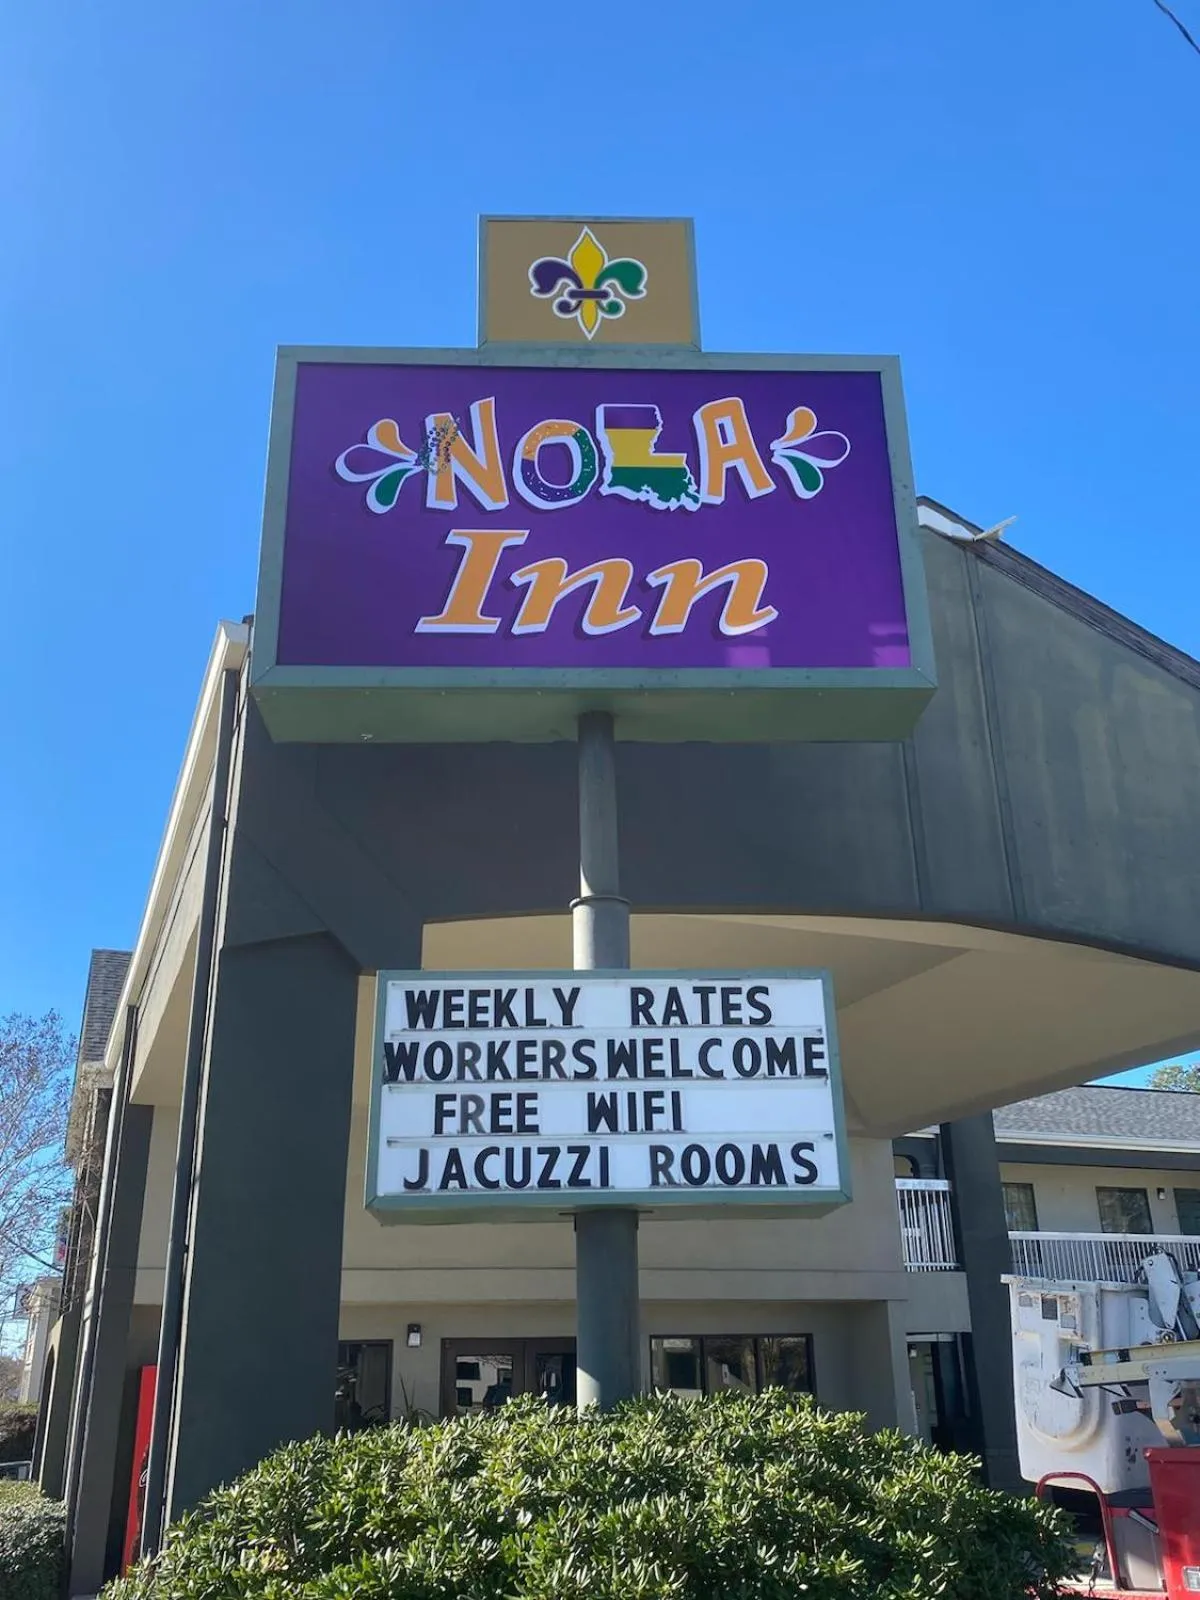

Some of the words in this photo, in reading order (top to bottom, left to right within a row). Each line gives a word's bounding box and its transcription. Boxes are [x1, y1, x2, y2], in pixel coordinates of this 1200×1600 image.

[424, 395, 776, 512] NOLA
[413, 528, 779, 637] Inn
[405, 986, 581, 1030] WEEKLY
[630, 985, 773, 1027] RATES
[384, 1038, 597, 1083] WORKERS
[606, 1036, 828, 1079] WELCOME
[434, 1092, 540, 1135] FREE
[587, 1090, 683, 1133] WIFI
[403, 1145, 610, 1190] JACUZZI
[649, 1142, 819, 1187] ROOMS
